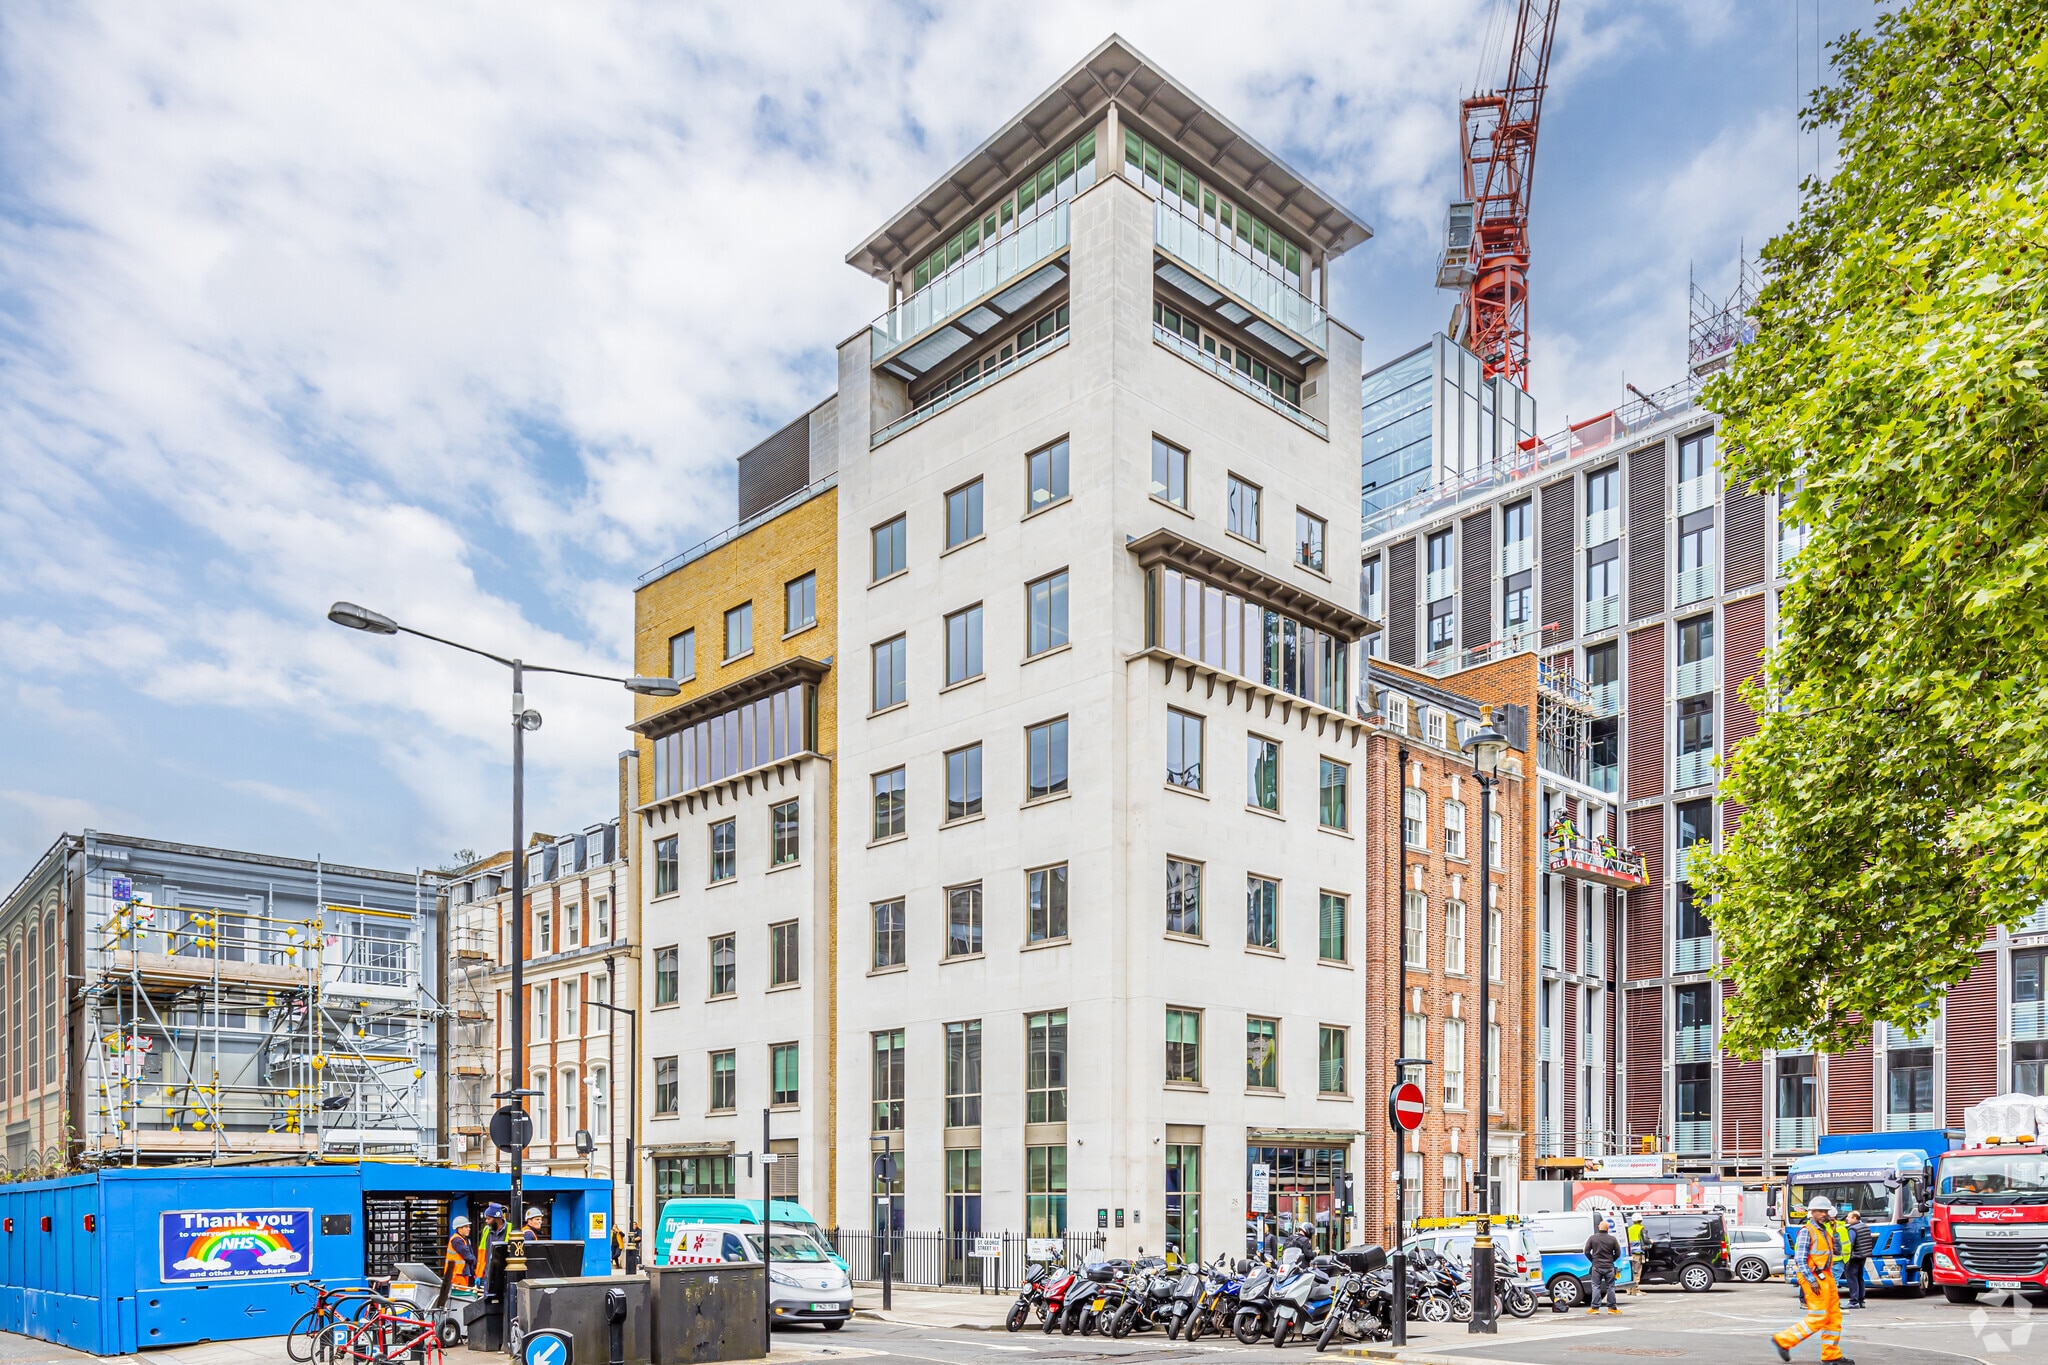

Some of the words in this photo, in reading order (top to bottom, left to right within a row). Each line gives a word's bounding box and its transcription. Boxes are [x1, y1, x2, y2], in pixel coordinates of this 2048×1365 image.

[180, 1213, 249, 1228] Thank
[256, 1214, 293, 1230] you
[191, 1230, 231, 1238] everyone
[221, 1237, 255, 1249] NHS
[234, 1269, 250, 1277] key
[335, 1331, 345, 1344] P
